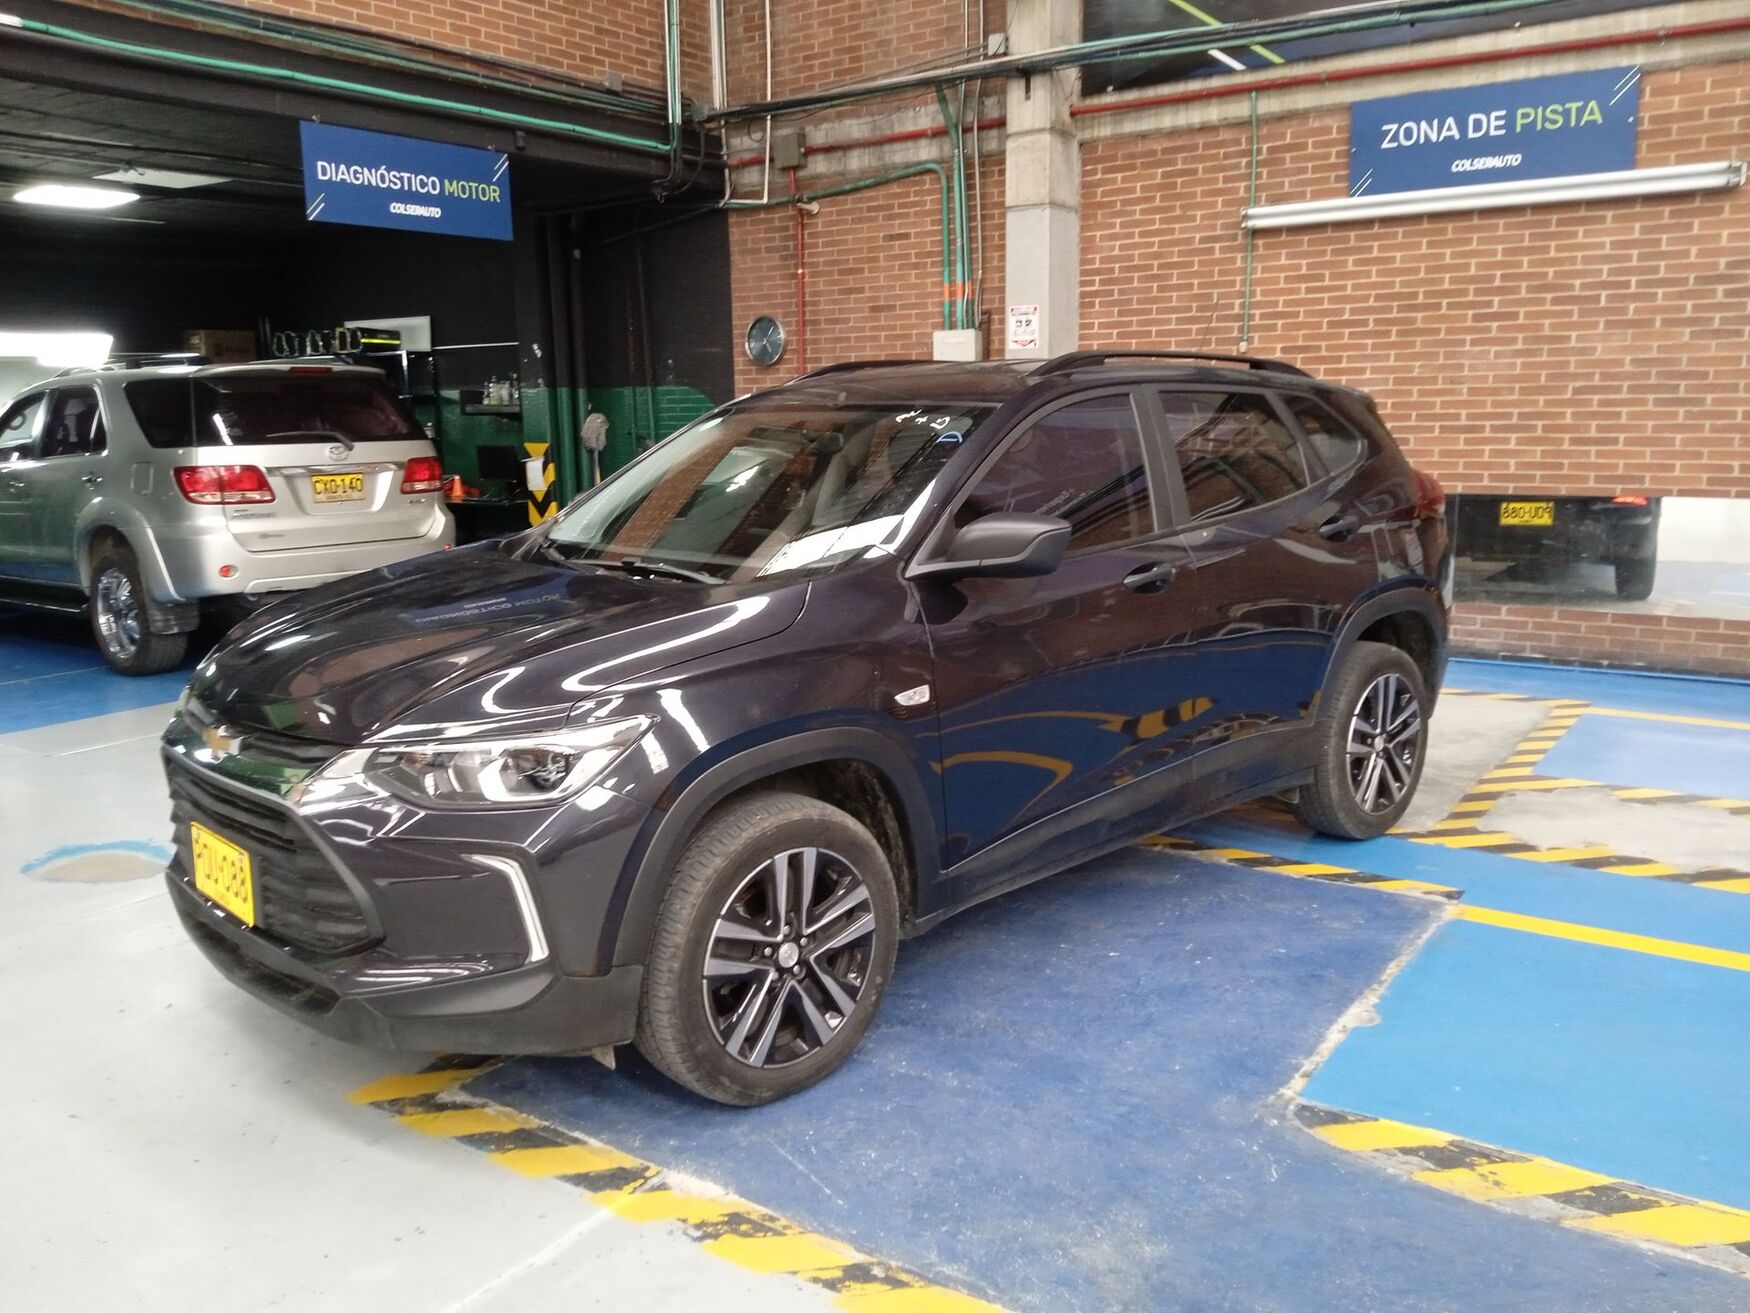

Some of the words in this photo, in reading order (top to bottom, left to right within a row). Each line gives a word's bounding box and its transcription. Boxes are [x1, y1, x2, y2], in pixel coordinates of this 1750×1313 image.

[1380, 116, 1461, 150] ZONA
[1467, 109, 1507, 139] DE
[1515, 99, 1604, 134] PISTA
[316, 160, 441, 195] DIAGNÓSTICO
[444, 178, 501, 203] MOTOR
